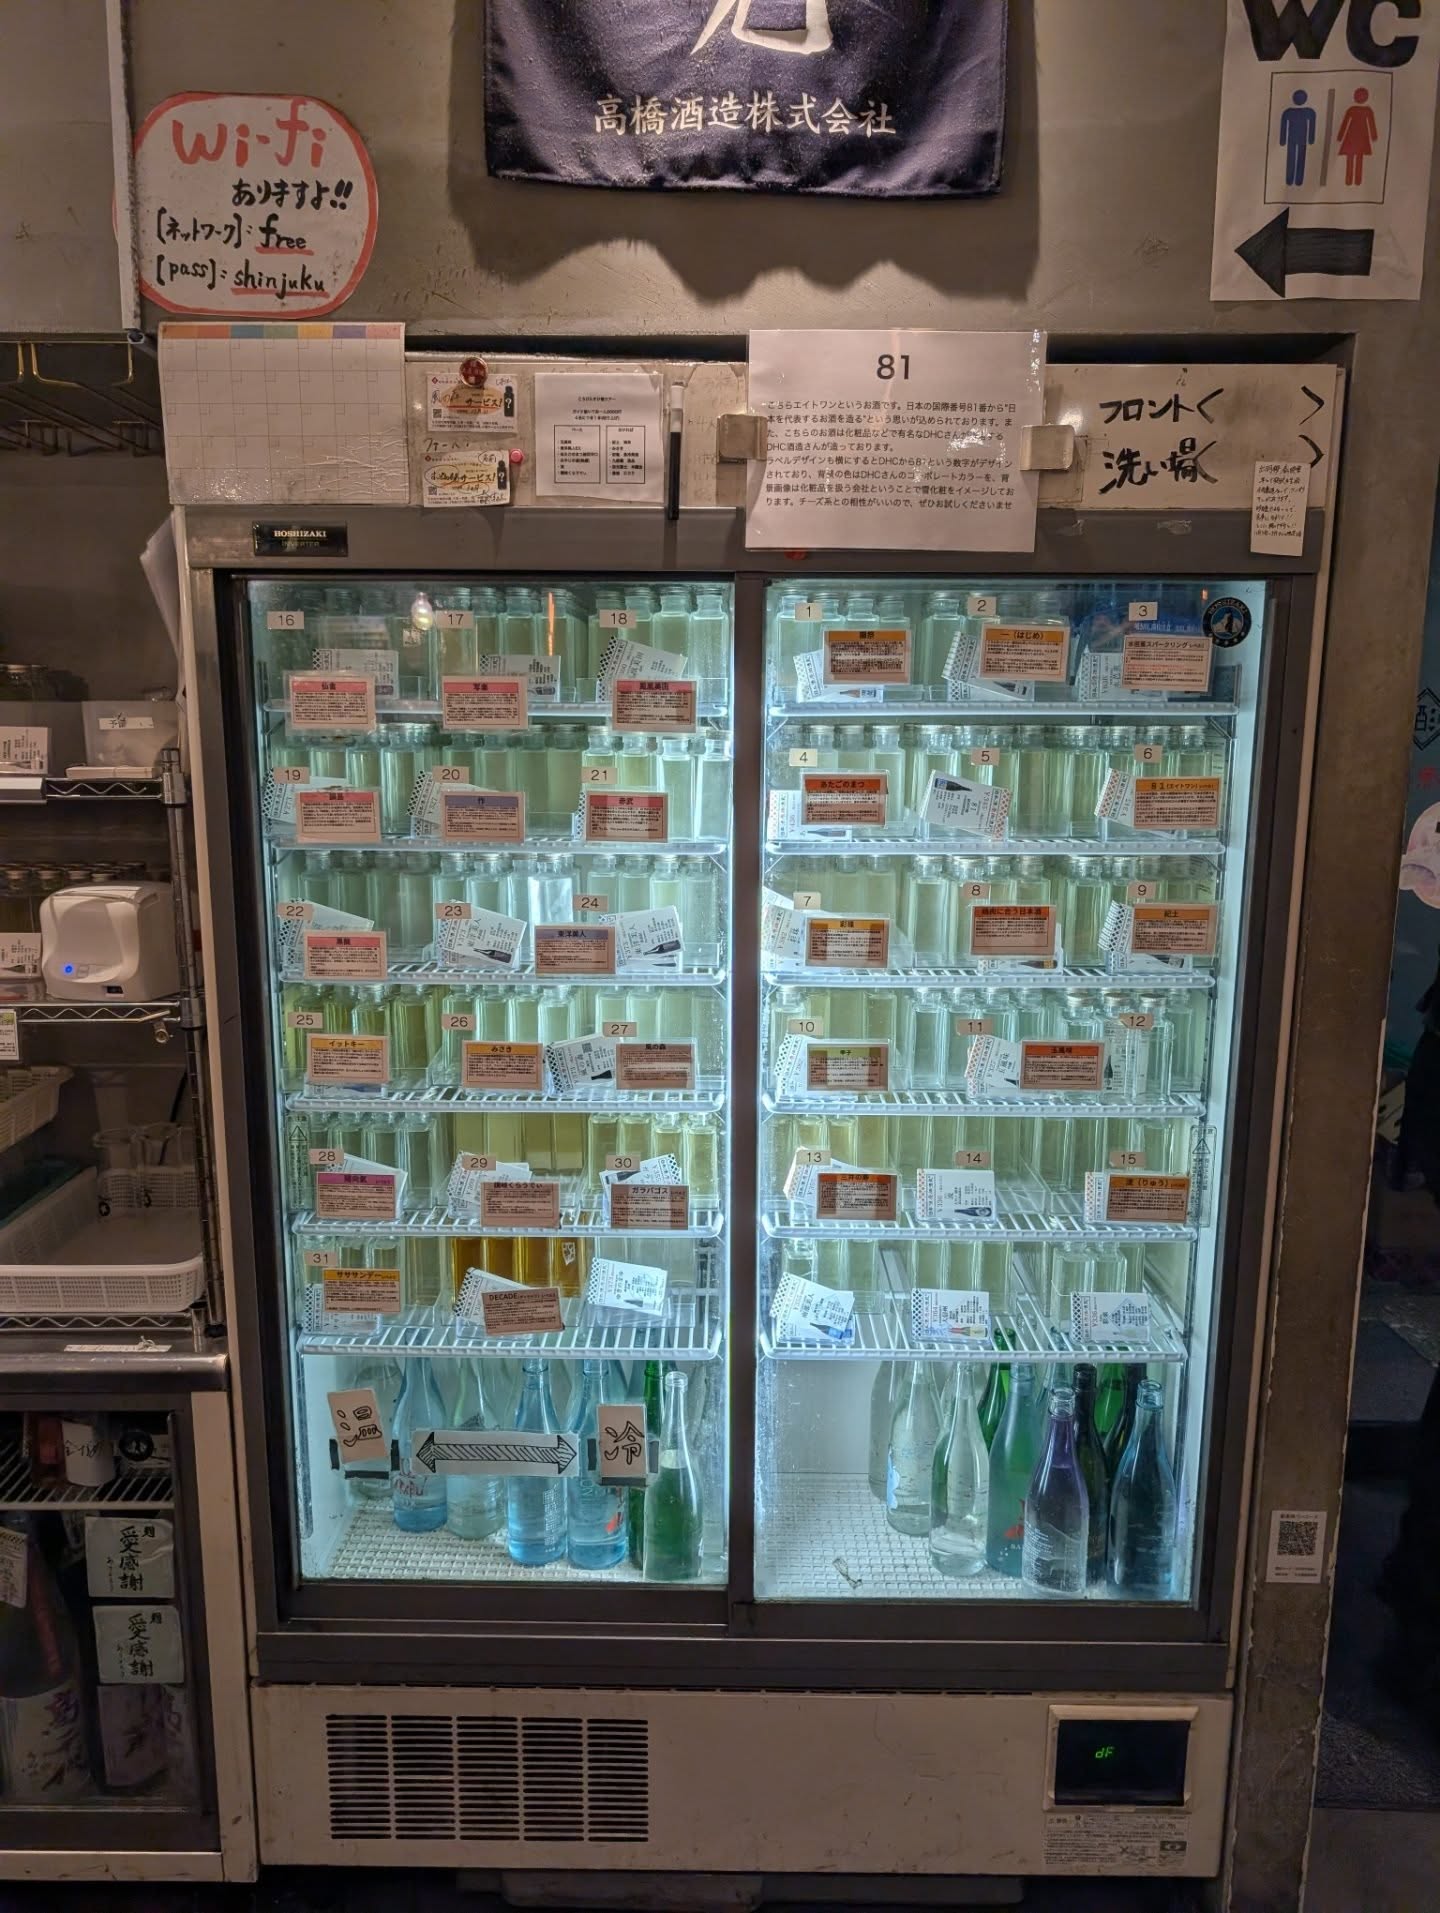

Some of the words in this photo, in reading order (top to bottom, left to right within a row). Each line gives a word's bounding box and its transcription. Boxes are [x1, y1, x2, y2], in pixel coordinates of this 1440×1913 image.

[1243, 0, 1421, 67] WC
[595, 90, 897, 138] 高橋酒造株式会社
[259, 213, 307, 249] free
[233, 259, 326, 300] shinjuku
[876, 354, 910, 380] 81
[274, 530, 327, 538] HOSHIZAKI
[806, 606, 812, 618] 1
[977, 600, 986, 612] 2
[1139, 605, 1148, 617] 3
[278, 614, 295, 626] 16
[448, 613, 464, 625] 17
[611, 612, 627, 625] 18
[799, 751, 808, 763] 4
[981, 750, 990, 762] 5
[1143, 747, 1153, 760] 6
[285, 769, 301, 781] 19
[441, 768, 460, 780] 20
[591, 769, 608, 781] 21
[820, 780, 866, 789] あたごのまつ
[971, 884, 981, 896] 8
[1137, 884, 1147, 896] 9
[581, 896, 599, 909] 24
[803, 896, 812, 907] 7
[286, 905, 304, 917] 22
[444, 904, 463, 917] 23
[557, 930, 587, 938] 東洋美人
[296, 1014, 314, 1026] 25
[450, 1016, 468, 1028] 26
[1129, 1015, 1146, 1027] 12
[611, 1024, 628, 1035] 27
[799, 1021, 815, 1033] 10
[967, 1021, 983, 1033] 11
[328, 1039, 364, 1048] イットキー
[491, 1045, 512, 1054] みさき
[318, 1150, 336, 1162] 28
[807, 1152, 822, 1163] 13
[966, 1152, 982, 1163] 14
[1121, 1153, 1137, 1165] 15
[470, 1157, 487, 1168] 29
[615, 1157, 632, 1168] 30
[313, 1253, 328, 1264] 31
[488, 1292, 518, 1301] DECADE
[336, 1405, 383, 1449] 温
[604, 1419, 646, 1466] 冷
